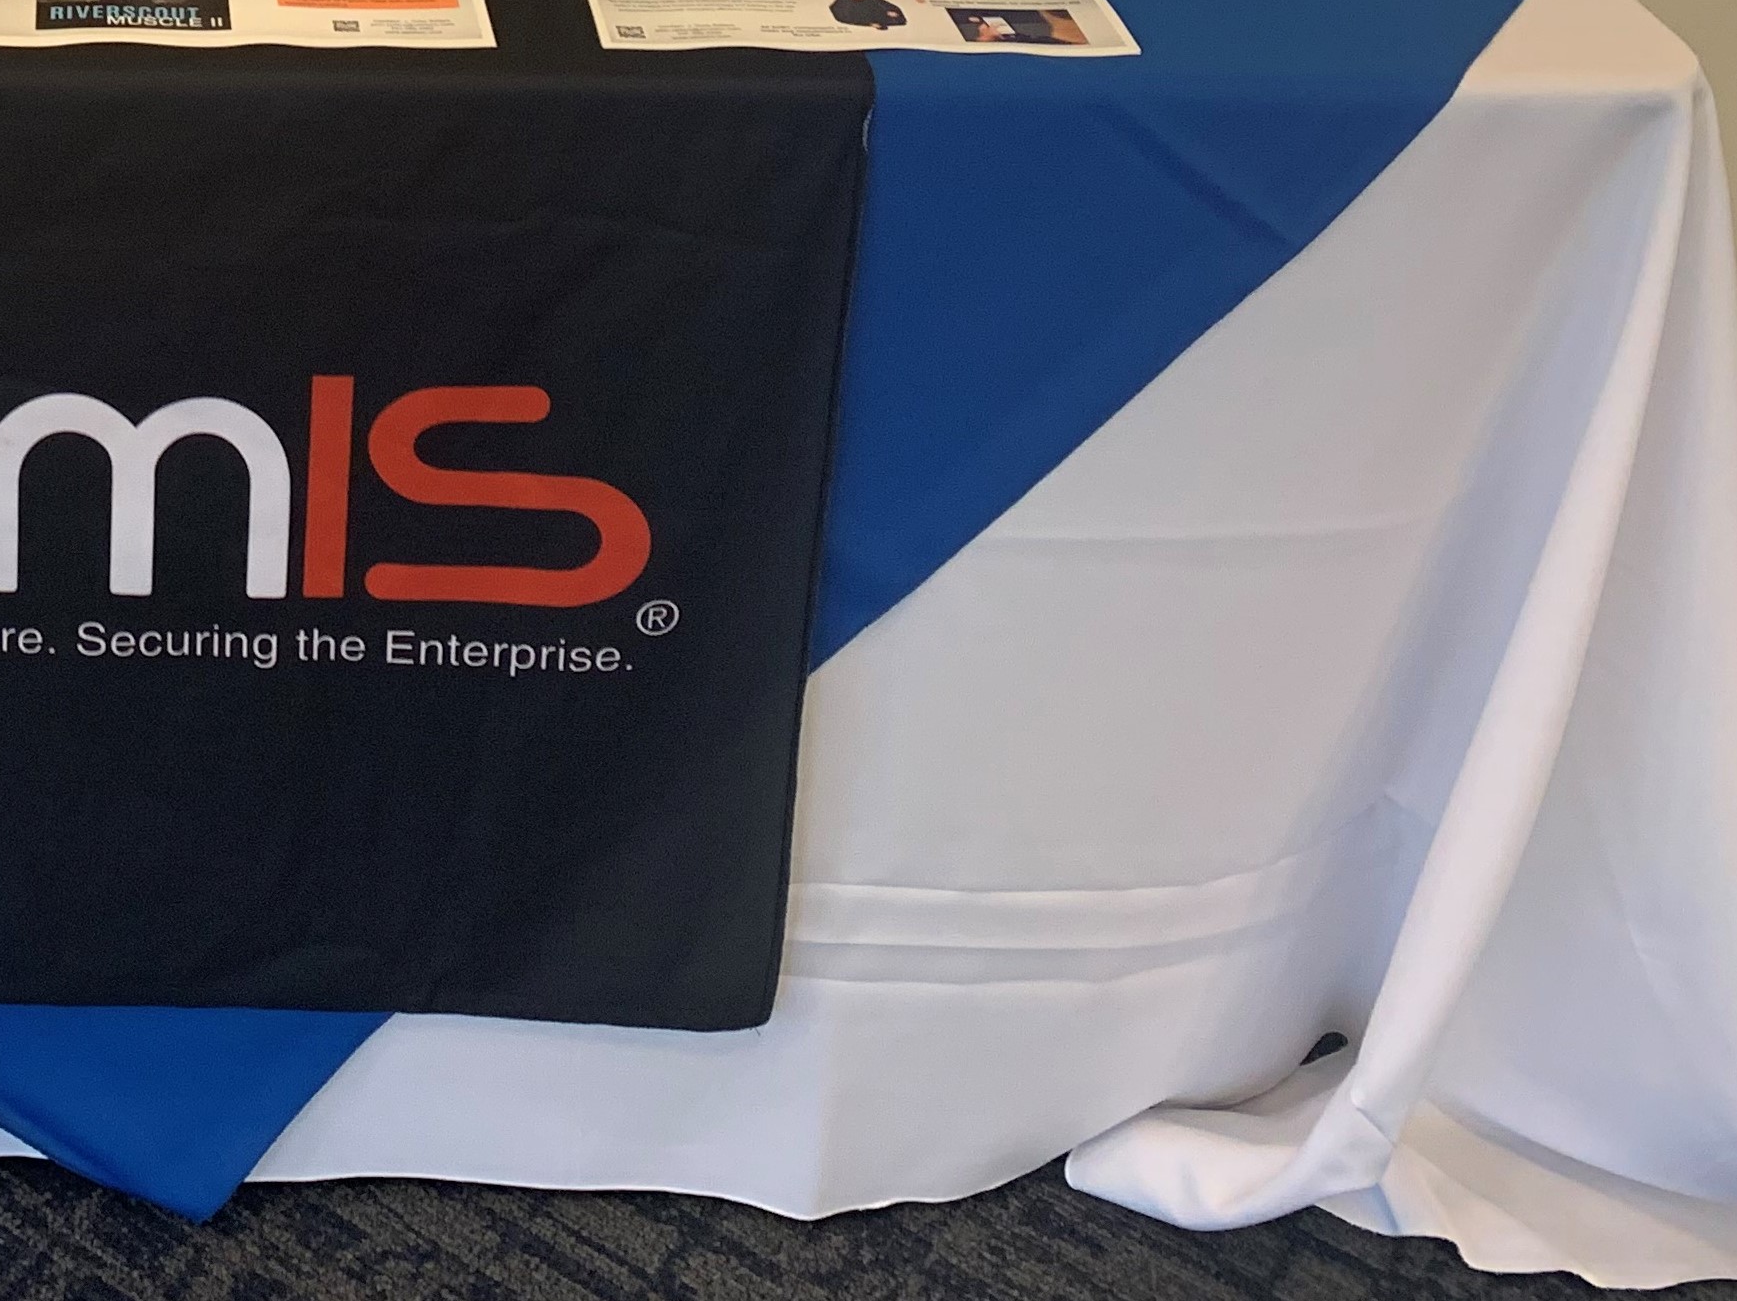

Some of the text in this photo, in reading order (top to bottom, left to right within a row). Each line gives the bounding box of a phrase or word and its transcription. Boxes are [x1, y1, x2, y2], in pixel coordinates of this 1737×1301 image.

[49, 4, 200, 20] RIVERSCOUT
[106, 15, 203, 28] MUSCLE
[76, 621, 278, 668] Securing
[296, 628, 365, 663] the
[385, 630, 634, 677] Enterprise.
